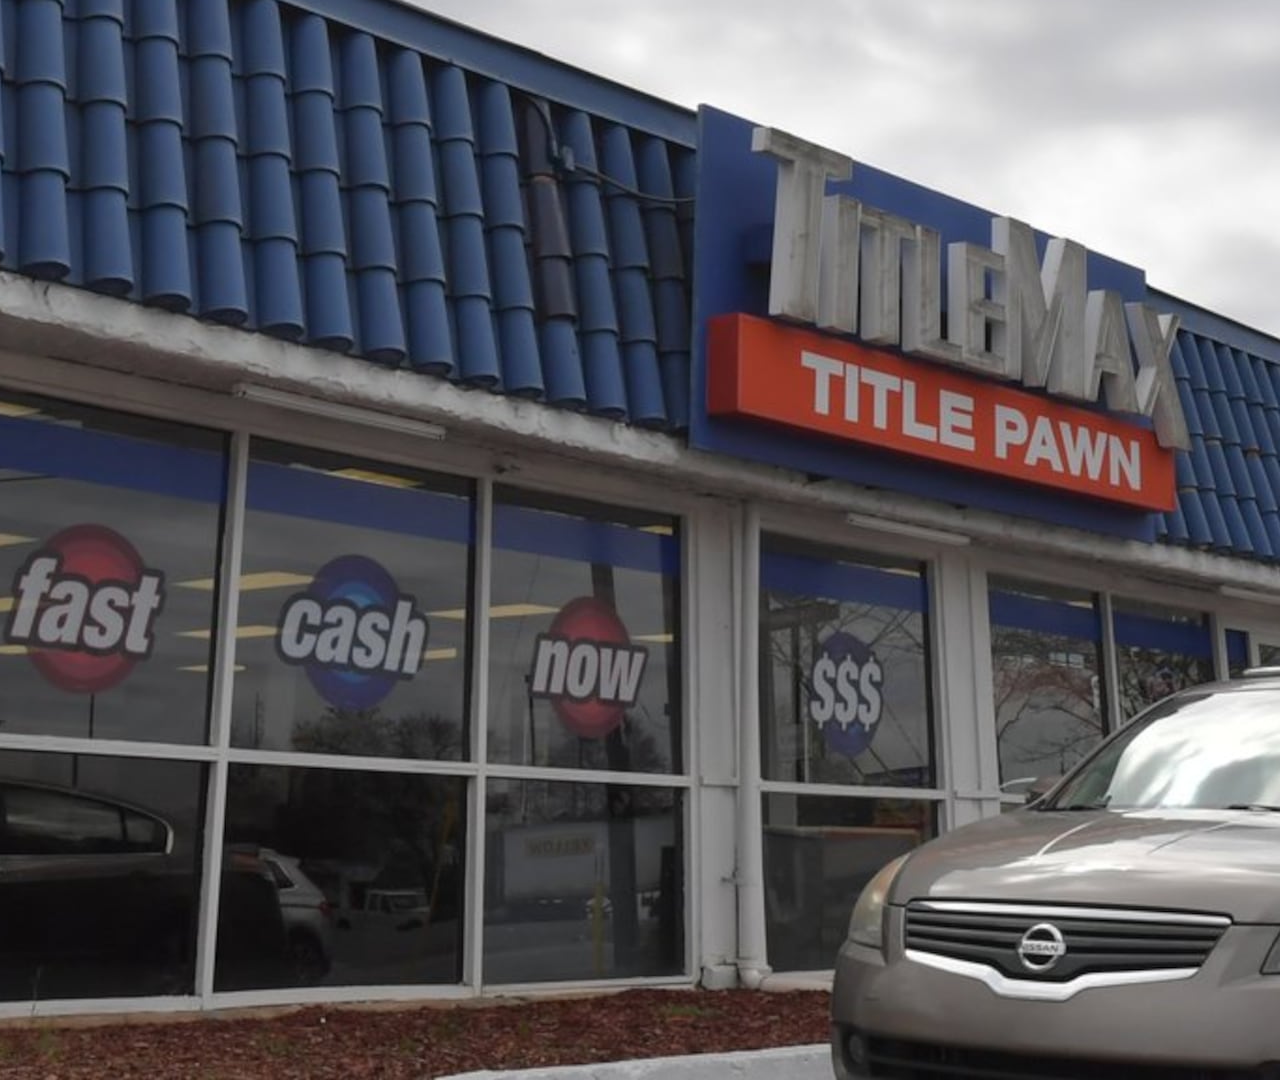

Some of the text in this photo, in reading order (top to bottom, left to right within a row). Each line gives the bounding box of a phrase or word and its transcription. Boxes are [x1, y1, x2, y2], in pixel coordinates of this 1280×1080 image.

[801, 351, 1141, 491] TITLE PAWN
[9, 556, 161, 655] fast
[280, 600, 426, 675] cash
[532, 641, 645, 703] now
[810, 651, 881, 732] $$$
